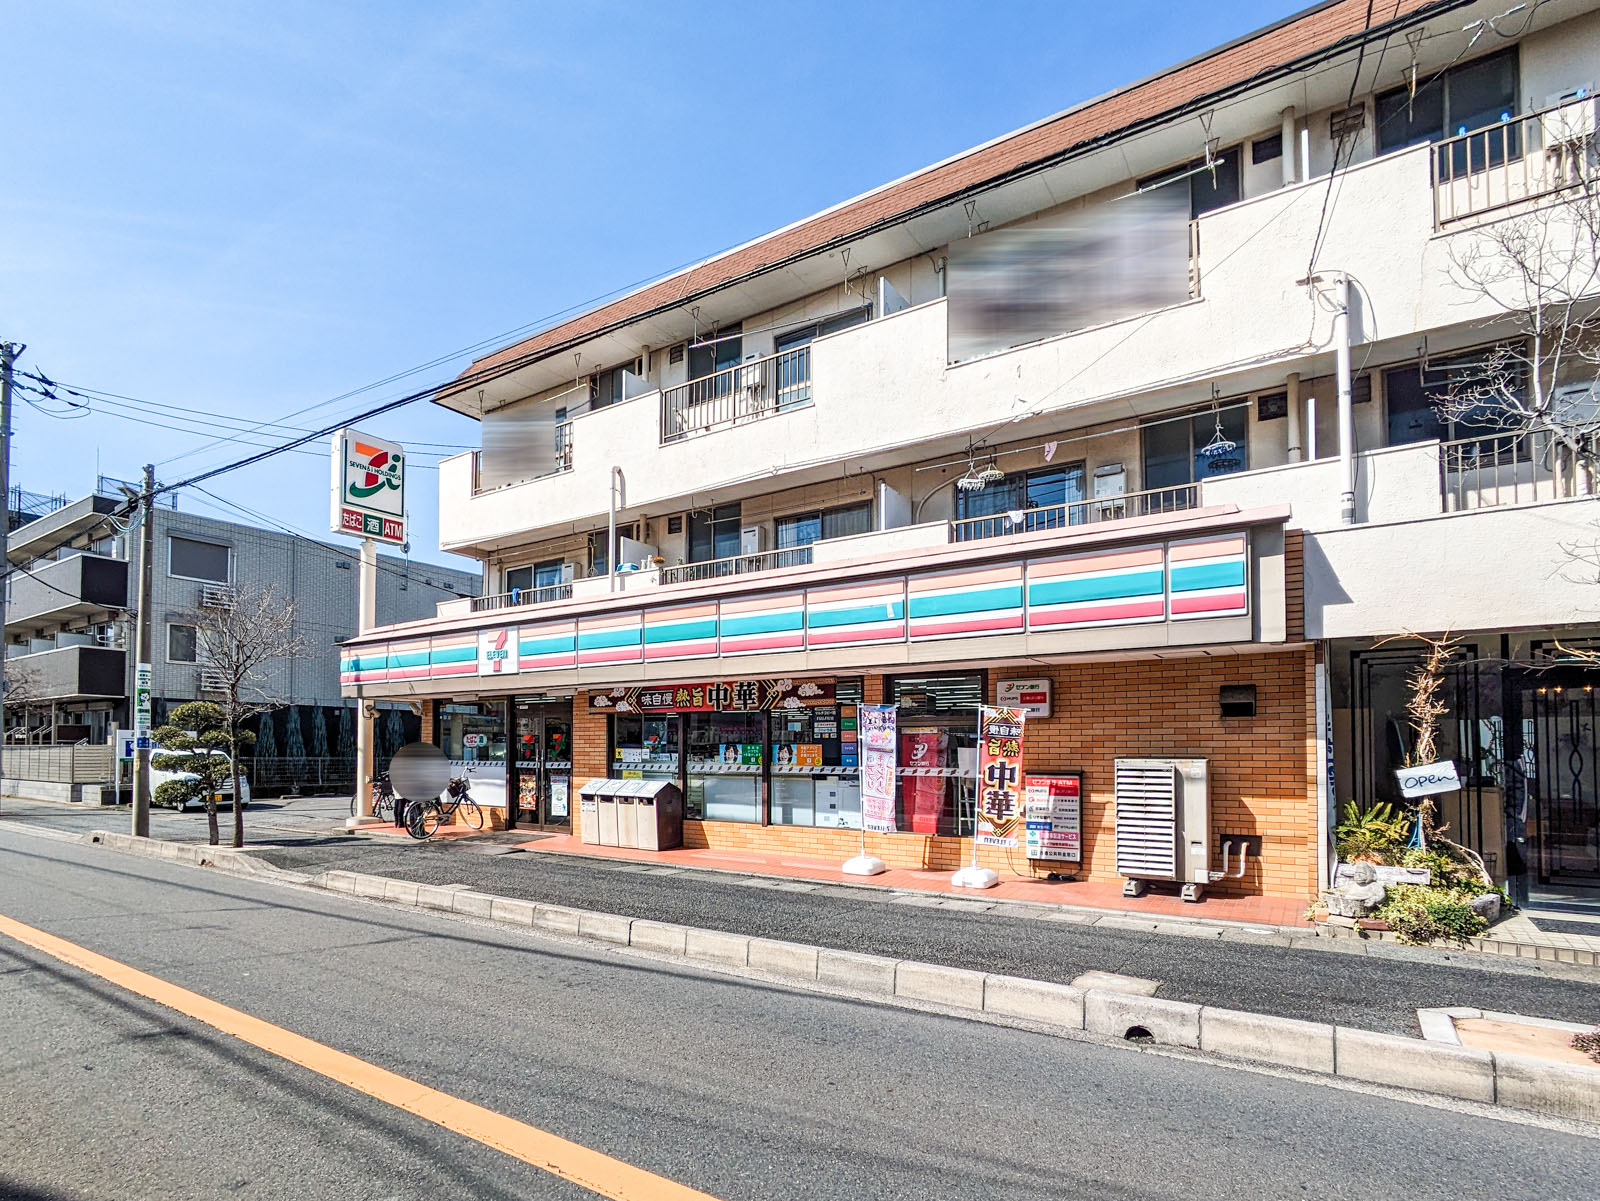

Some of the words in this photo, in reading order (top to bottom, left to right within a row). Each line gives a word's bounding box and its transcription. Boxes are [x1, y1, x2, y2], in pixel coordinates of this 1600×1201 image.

[349, 460, 367, 471] SEVEN
[374, 467, 401, 481] HOLDINGS
[342, 512, 362, 529] たばこ
[366, 517, 380, 532] 酒
[384, 522, 403, 538] ATM
[641, 692, 673, 706] 味自慢
[674, 687, 704, 709] 熱旨
[707, 680, 760, 712] 中華
